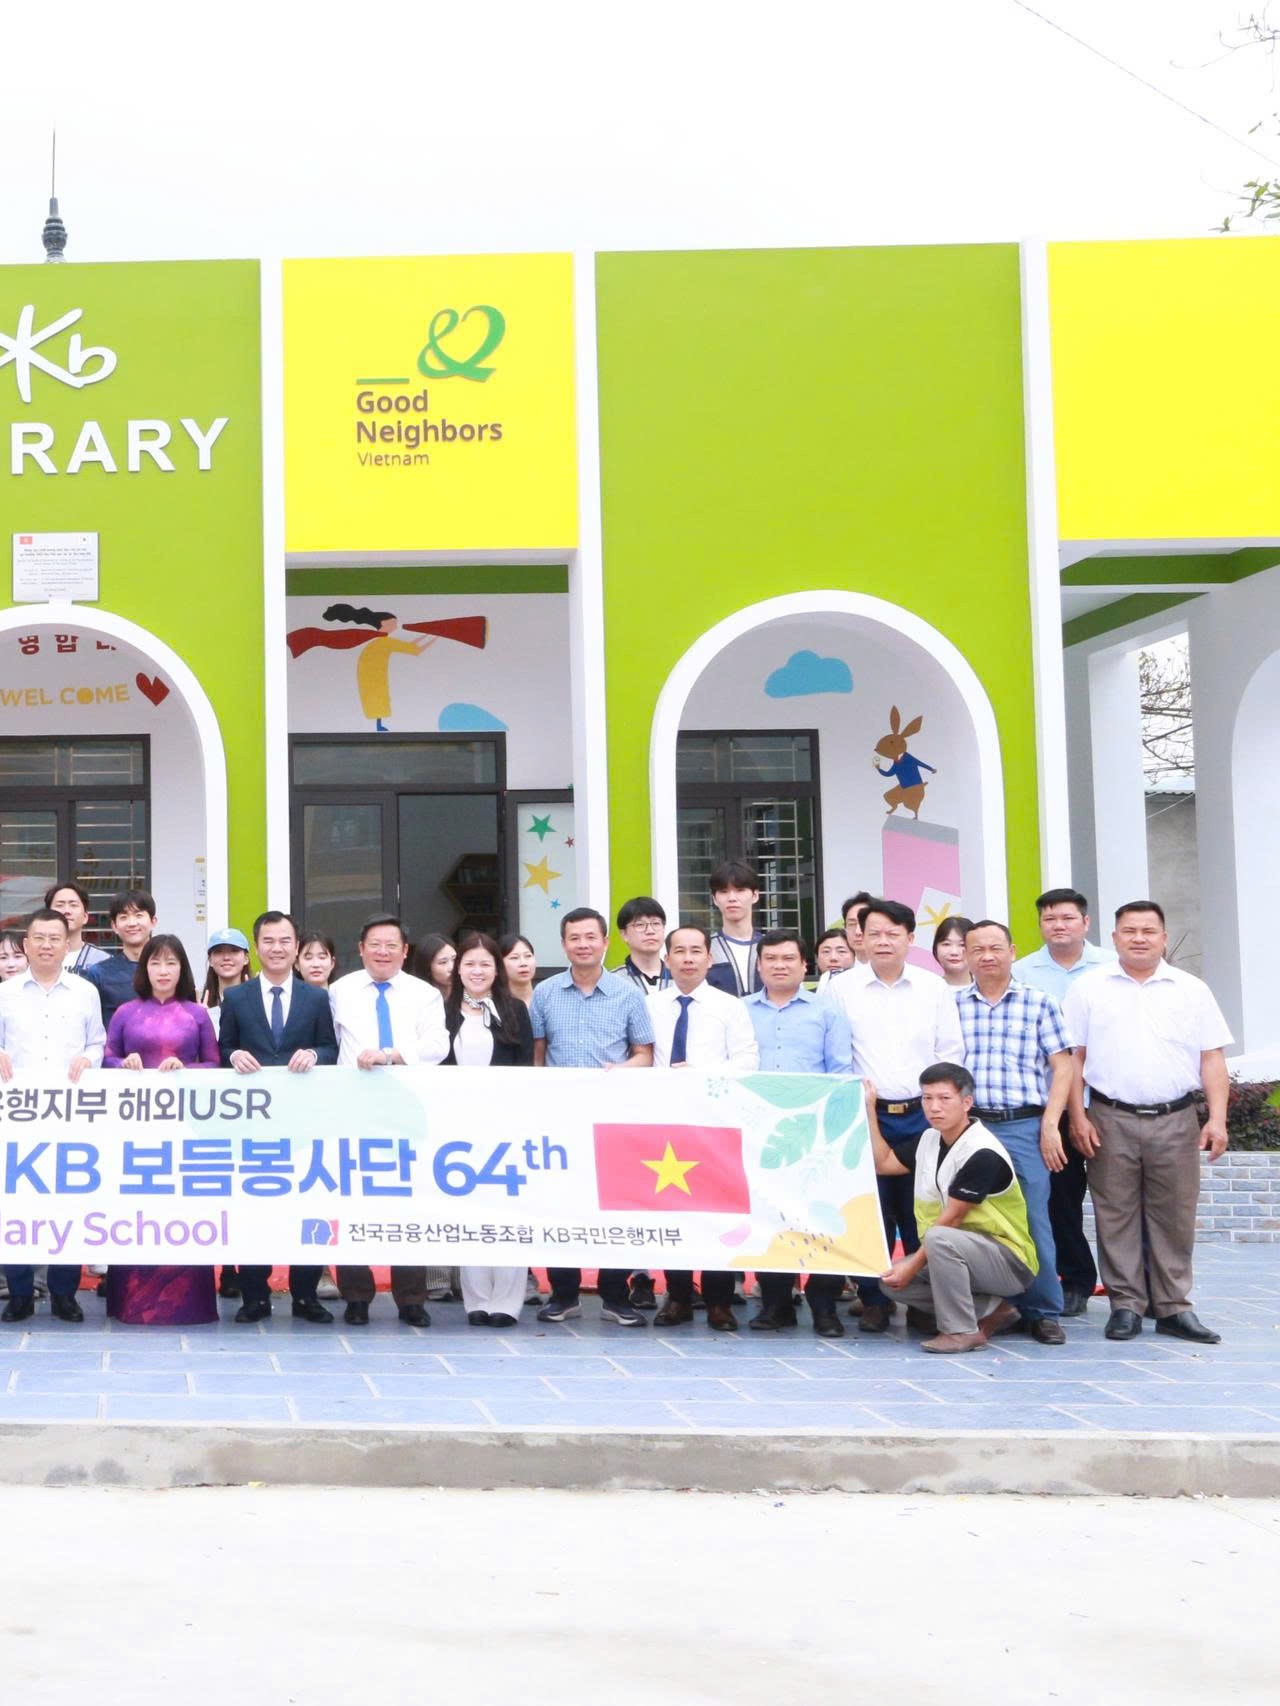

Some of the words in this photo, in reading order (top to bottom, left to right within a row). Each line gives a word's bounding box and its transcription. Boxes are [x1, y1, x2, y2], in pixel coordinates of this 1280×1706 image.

[356, 389, 428, 413] Good
[356, 418, 503, 449] Neighbors
[357, 452, 429, 466] Vietnam
[119, 1087, 272, 1122] 해외USR
[4, 1141, 101, 1194] KB
[120, 1138, 417, 1197] 보듬봉사단
[432, 1136, 568, 1196] 64th
[83, 1210, 228, 1247] School
[348, 1223, 534, 1244] 전국금융산업노동조합
[543, 1226, 682, 1246] KB국민은행지부
